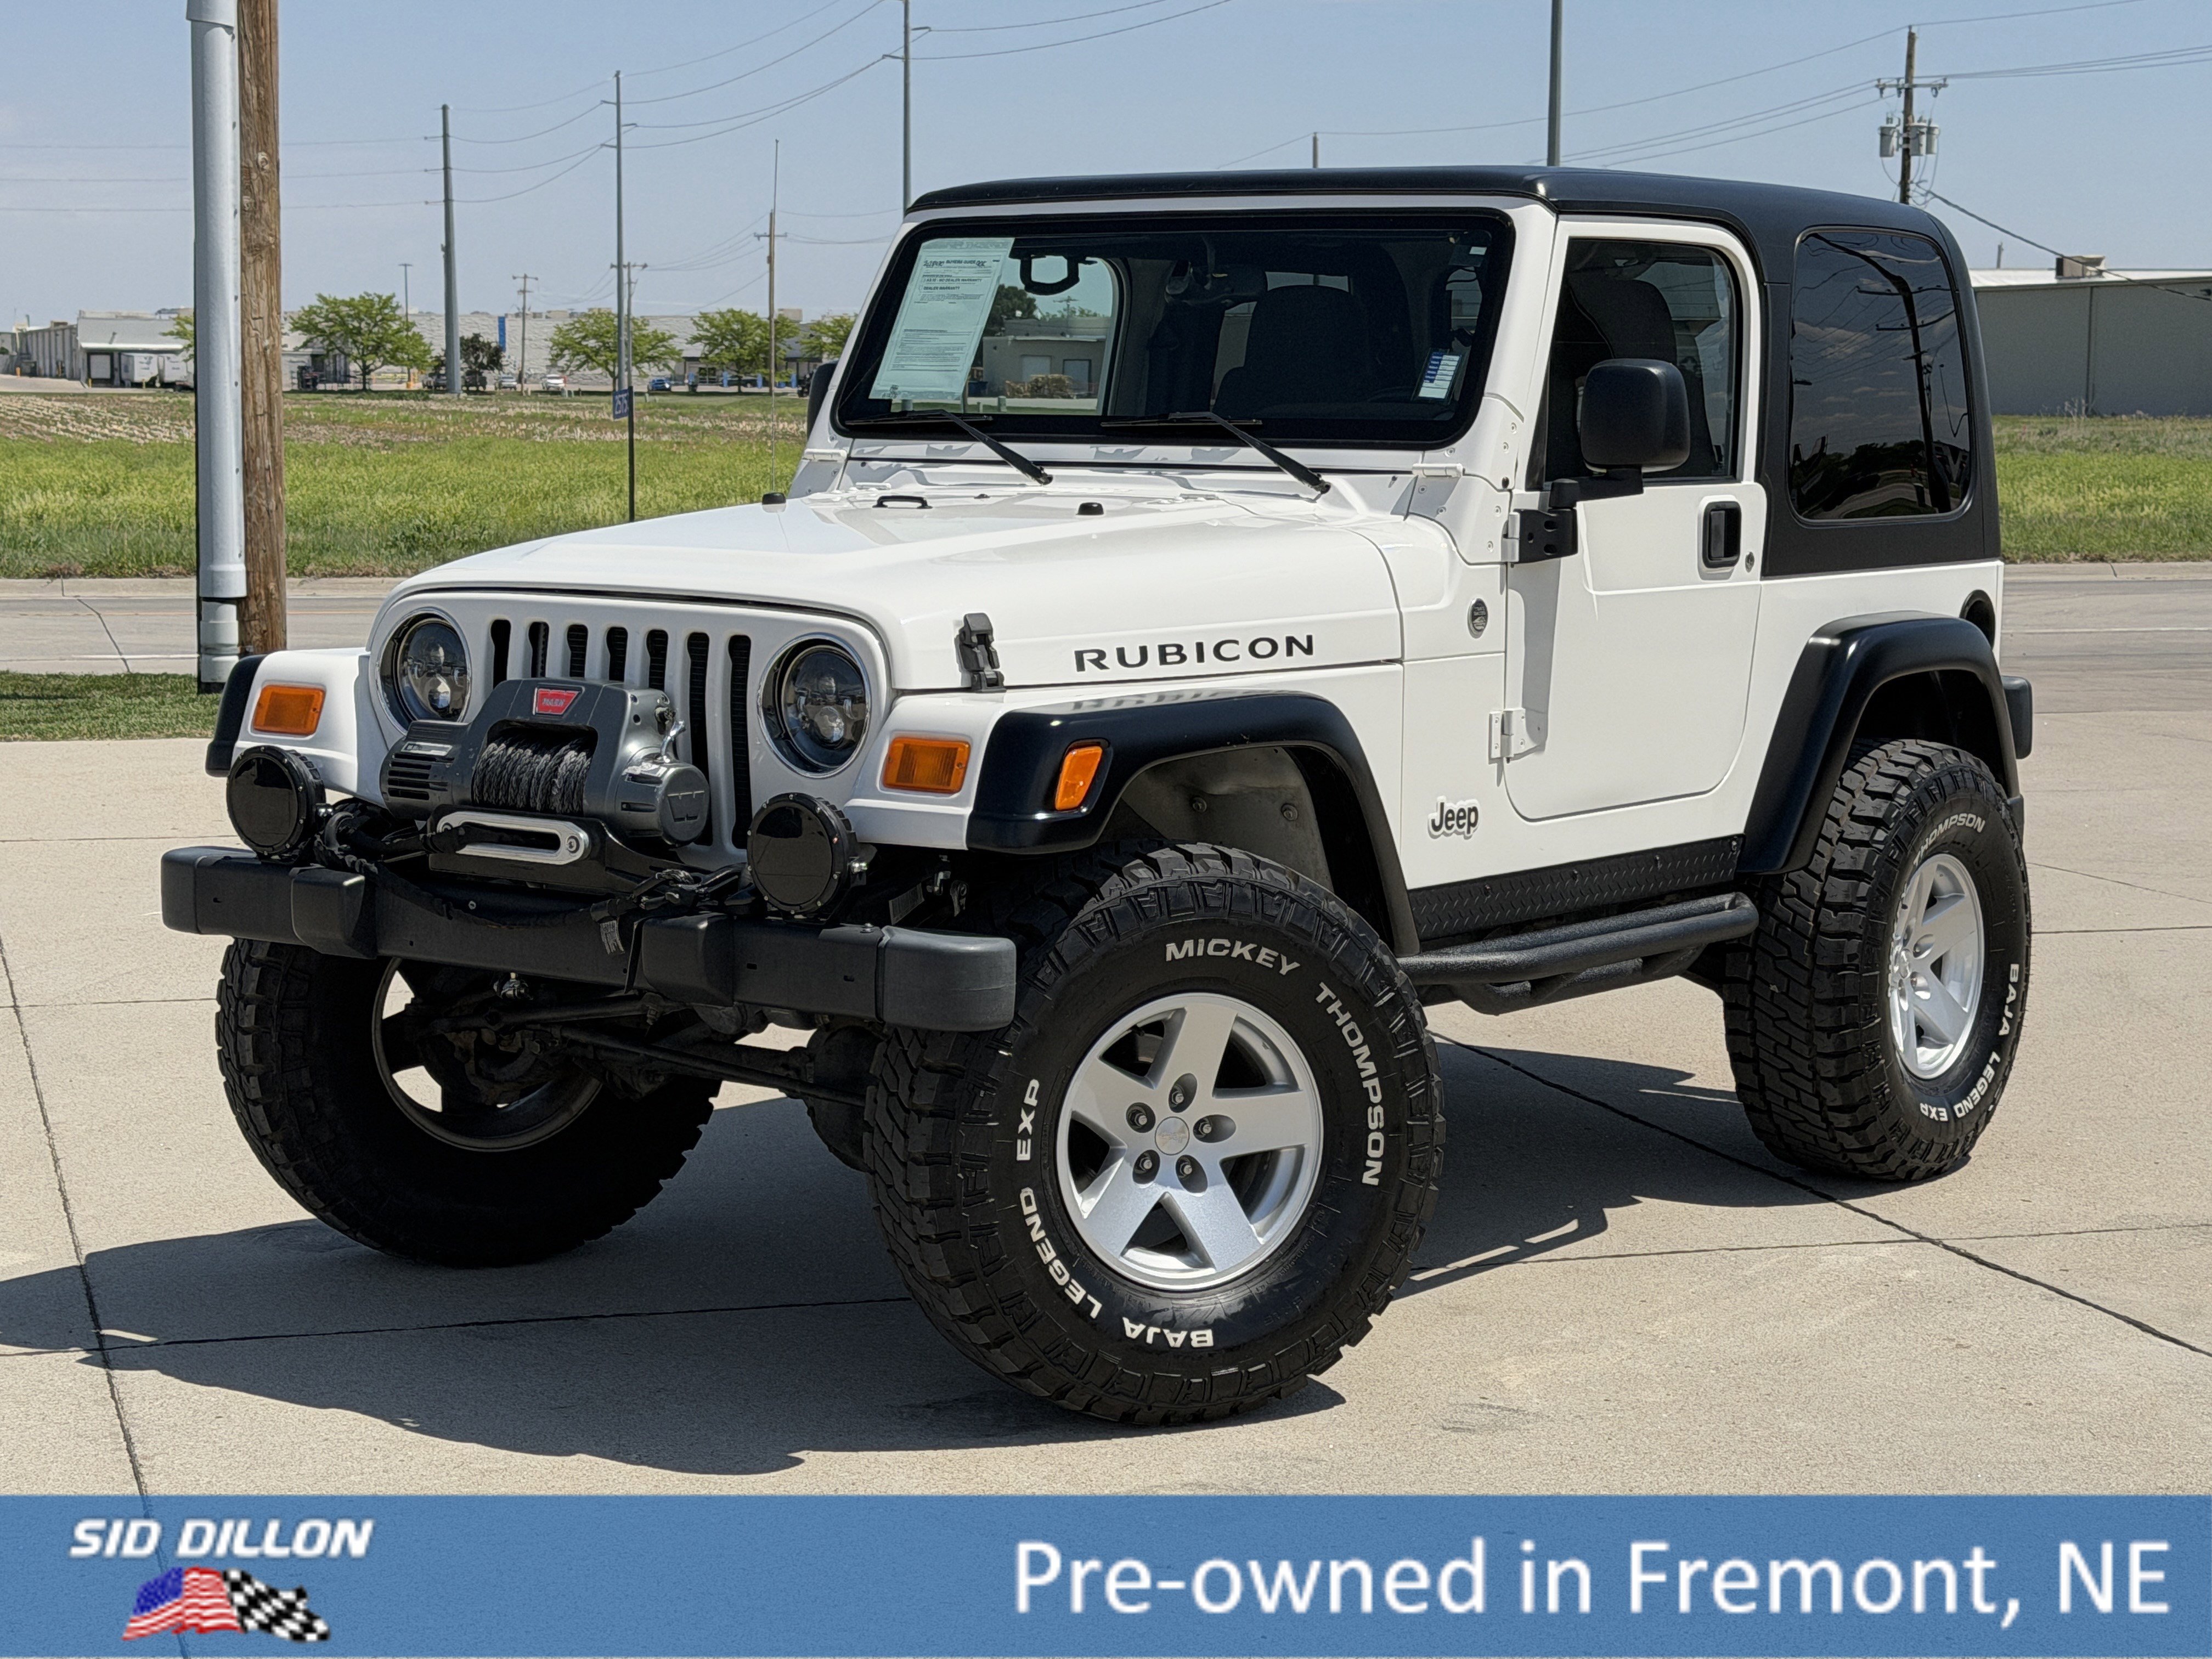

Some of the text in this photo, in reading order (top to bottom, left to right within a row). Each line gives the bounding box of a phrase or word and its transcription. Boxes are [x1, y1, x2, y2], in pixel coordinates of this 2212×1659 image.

[1074, 634, 1313, 672] RUBICON
[1431, 802, 1479, 834] Jeep
[1913, 812, 1986, 867] THOMPSON
[1165, 938, 1385, 1187] MICKEY THOMPSON
[1920, 963, 2020, 1121] BAJA LEGEND EXP
[1016, 1079, 1214, 1348] BAJA LEGEND EXP
